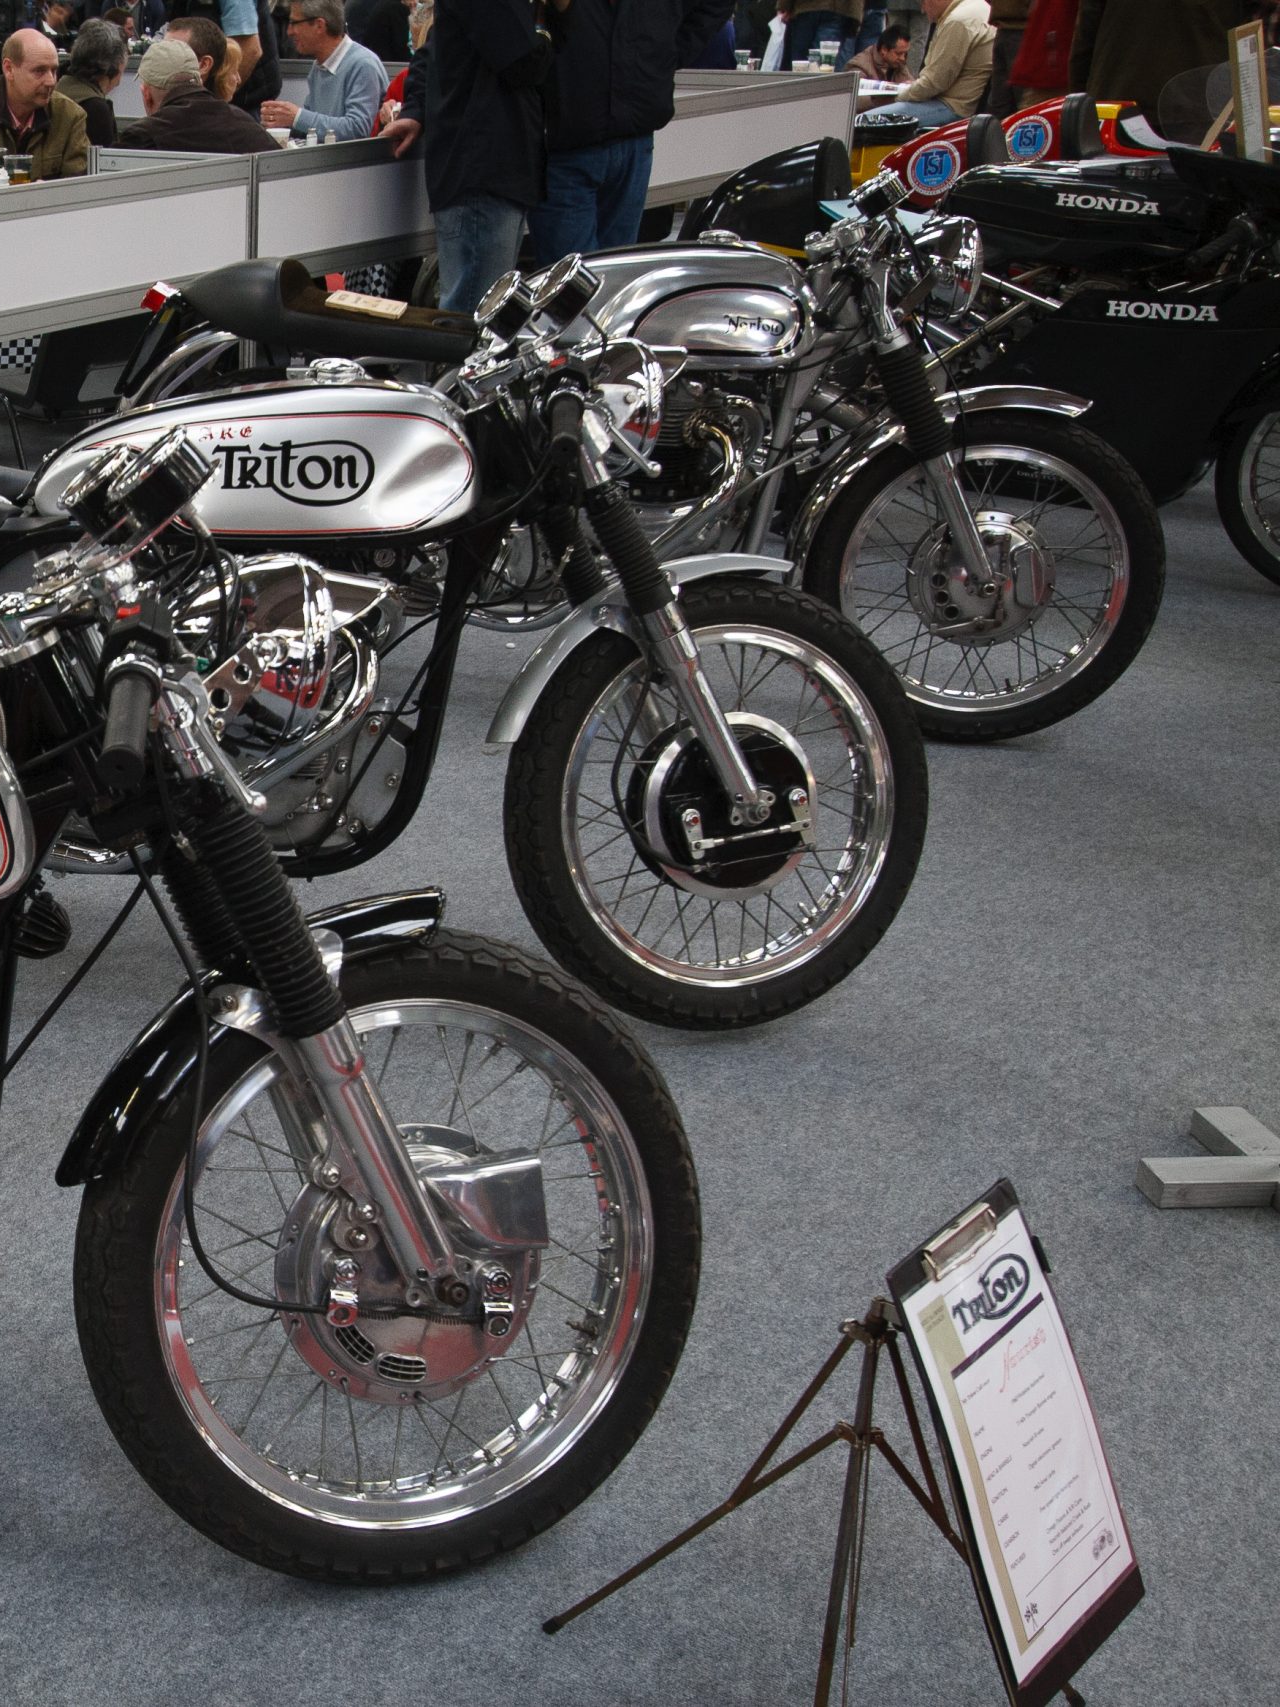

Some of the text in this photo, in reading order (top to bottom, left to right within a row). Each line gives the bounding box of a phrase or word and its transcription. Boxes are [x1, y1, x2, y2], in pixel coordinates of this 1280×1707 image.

[1055, 193, 1160, 215] HONDA
[1106, 300, 1219, 322] HONDA
[723, 314, 786, 336] Norton
